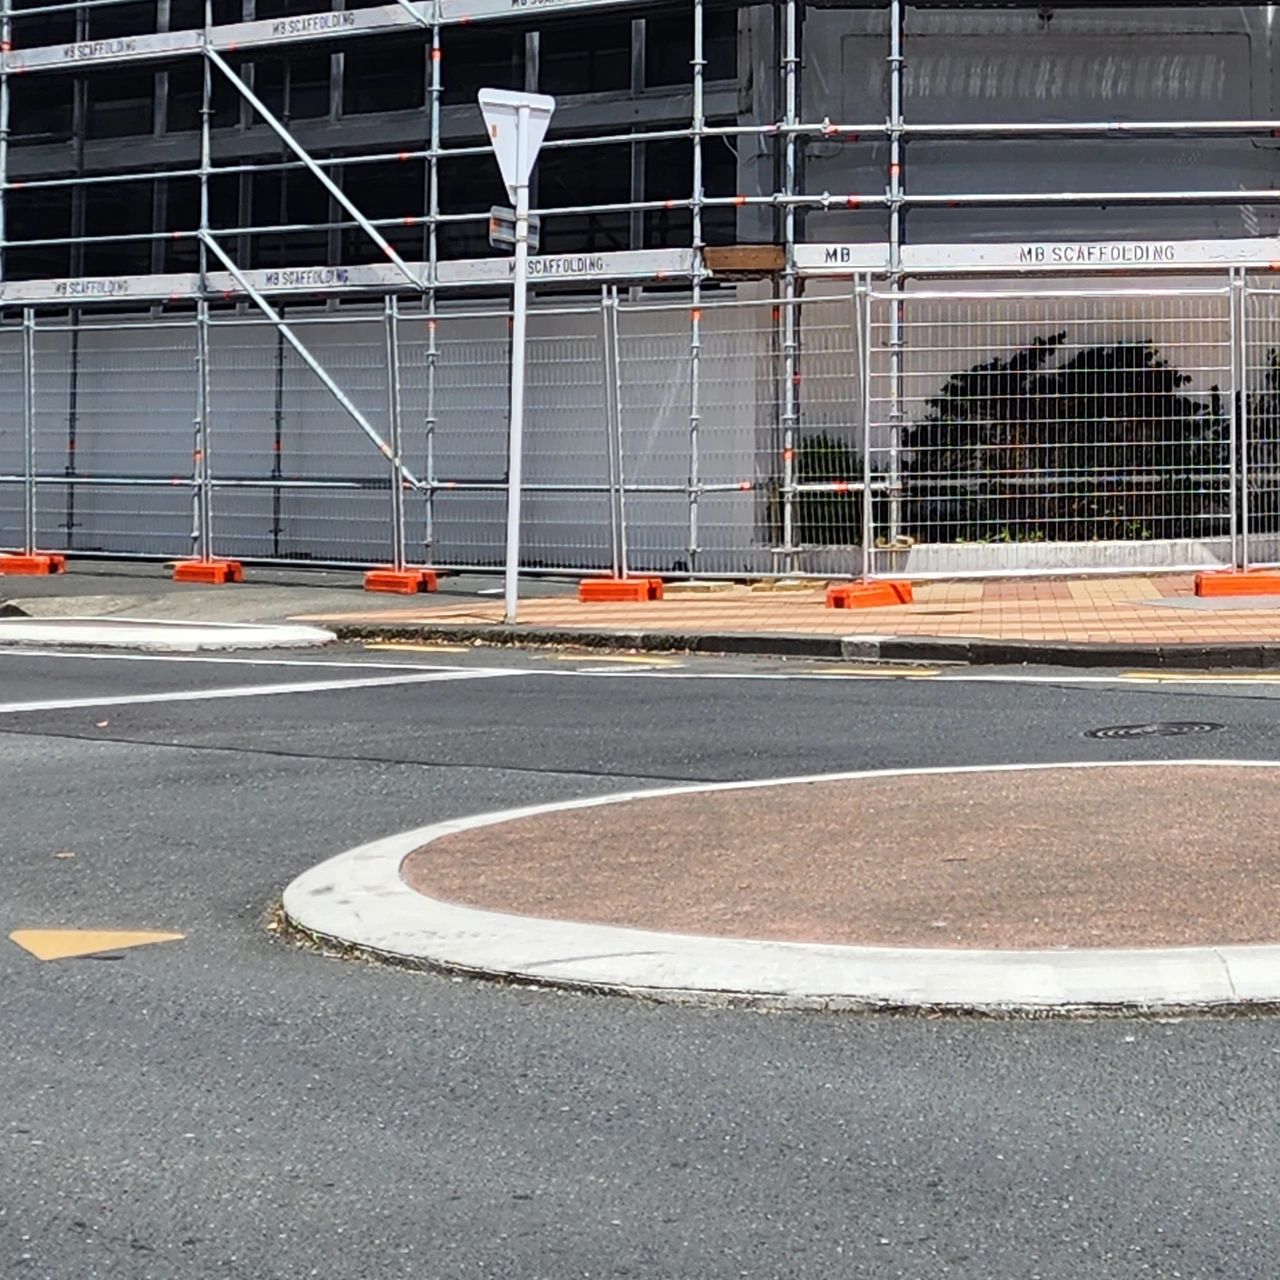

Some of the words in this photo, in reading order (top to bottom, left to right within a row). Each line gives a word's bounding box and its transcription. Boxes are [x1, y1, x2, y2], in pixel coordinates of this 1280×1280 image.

[272, 22, 286, 35] MB
[288, 12, 355, 33] SCAFFOLDING
[77, 39, 136, 57] SCAFFOLDING
[825, 247, 851, 263] MB
[1020, 247, 1045, 262] MB
[1052, 245, 1175, 262] SCAFFOLDING
[528, 258, 603, 274] SCAFFOLDING
[266, 272, 279, 285] MB
[282, 269, 350, 285] SCAFFOLDING
[69, 279, 128, 295] SCAFFOLDING
